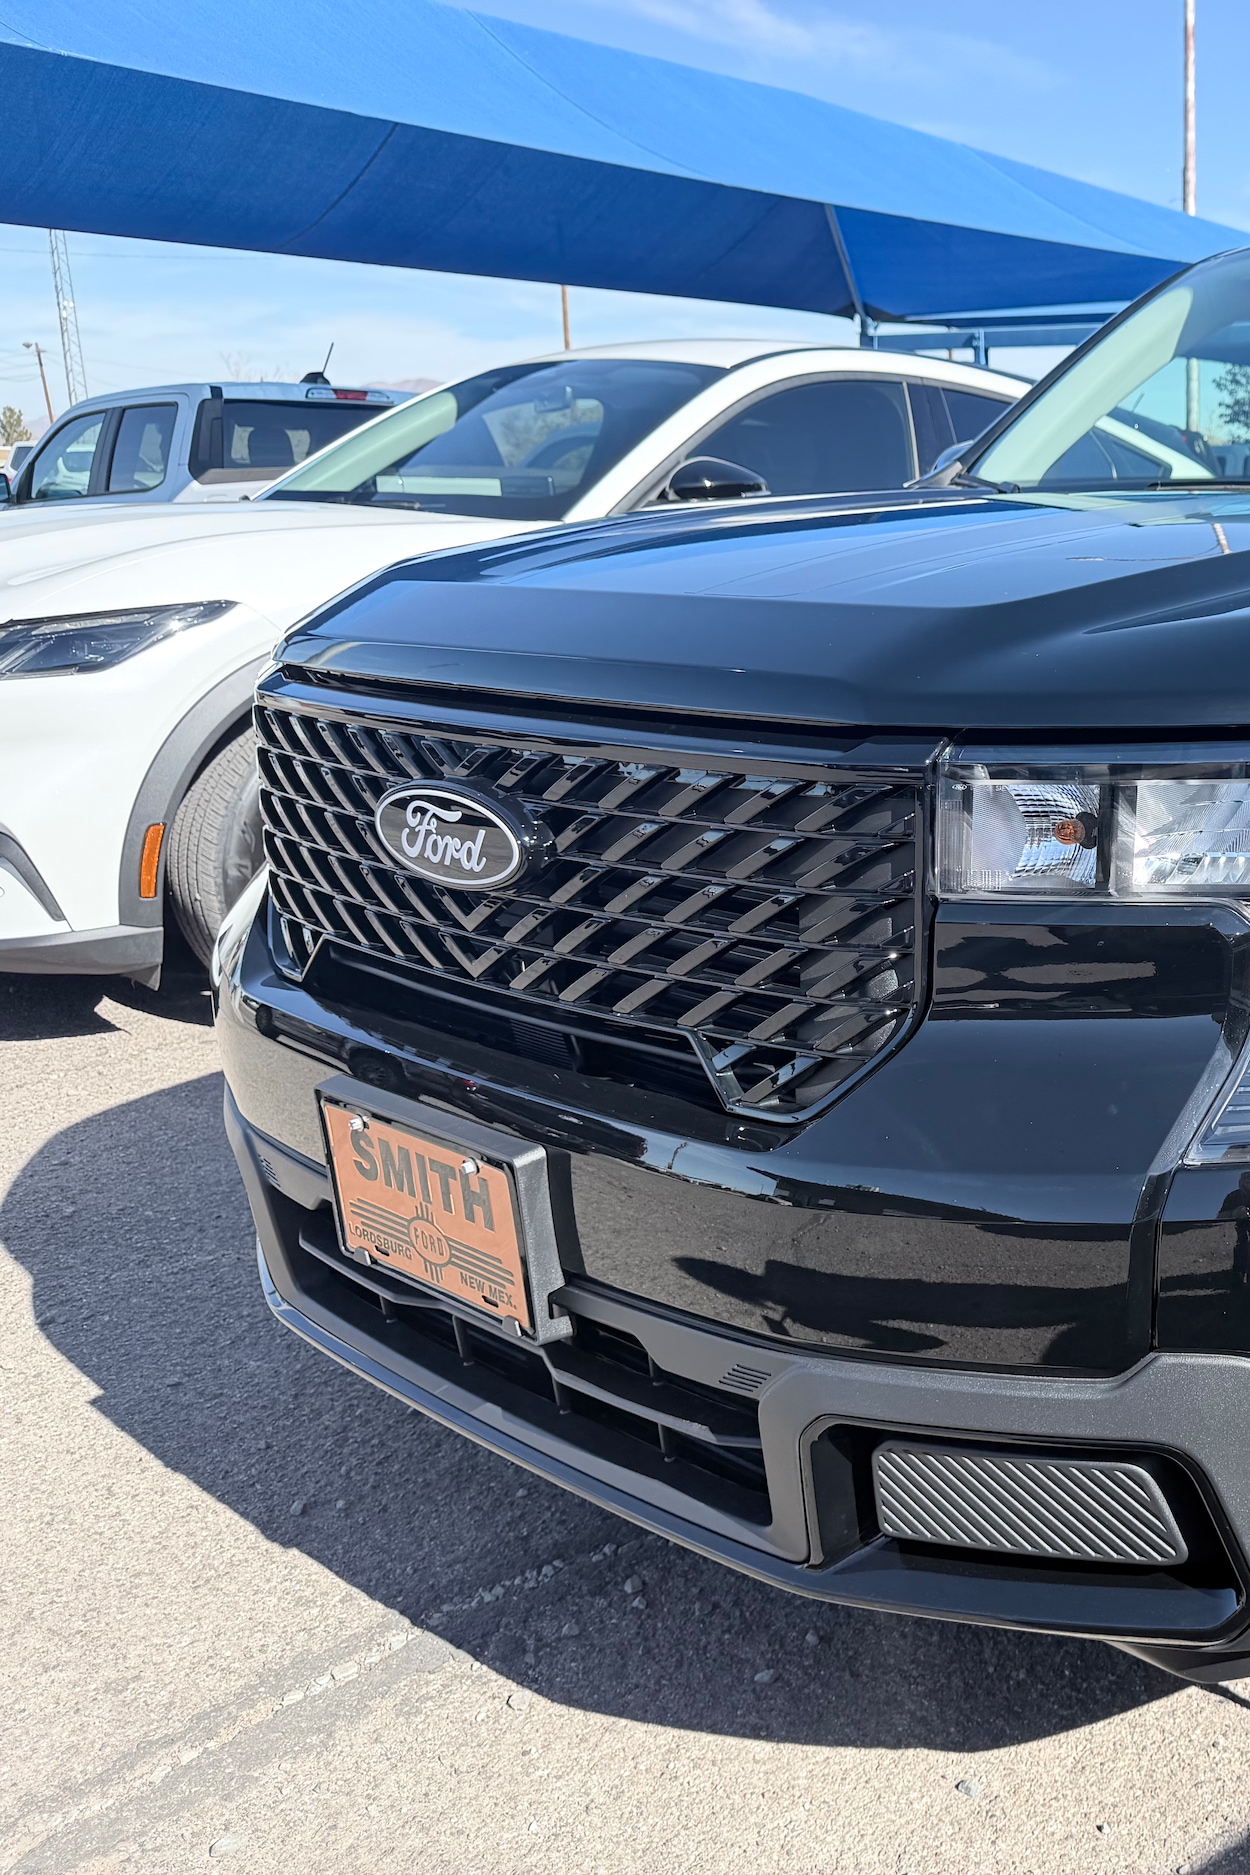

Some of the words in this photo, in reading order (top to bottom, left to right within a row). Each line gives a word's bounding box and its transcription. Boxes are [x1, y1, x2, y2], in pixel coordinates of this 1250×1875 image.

[400, 799, 488, 873] Ford
[349, 1128, 495, 1232] SMITH
[347, 1221, 413, 1261] LORDSBURG
[412, 1226, 445, 1258] FORD
[459, 1270, 486, 1295] NEW
[488, 1283, 518, 1310] MEX.
